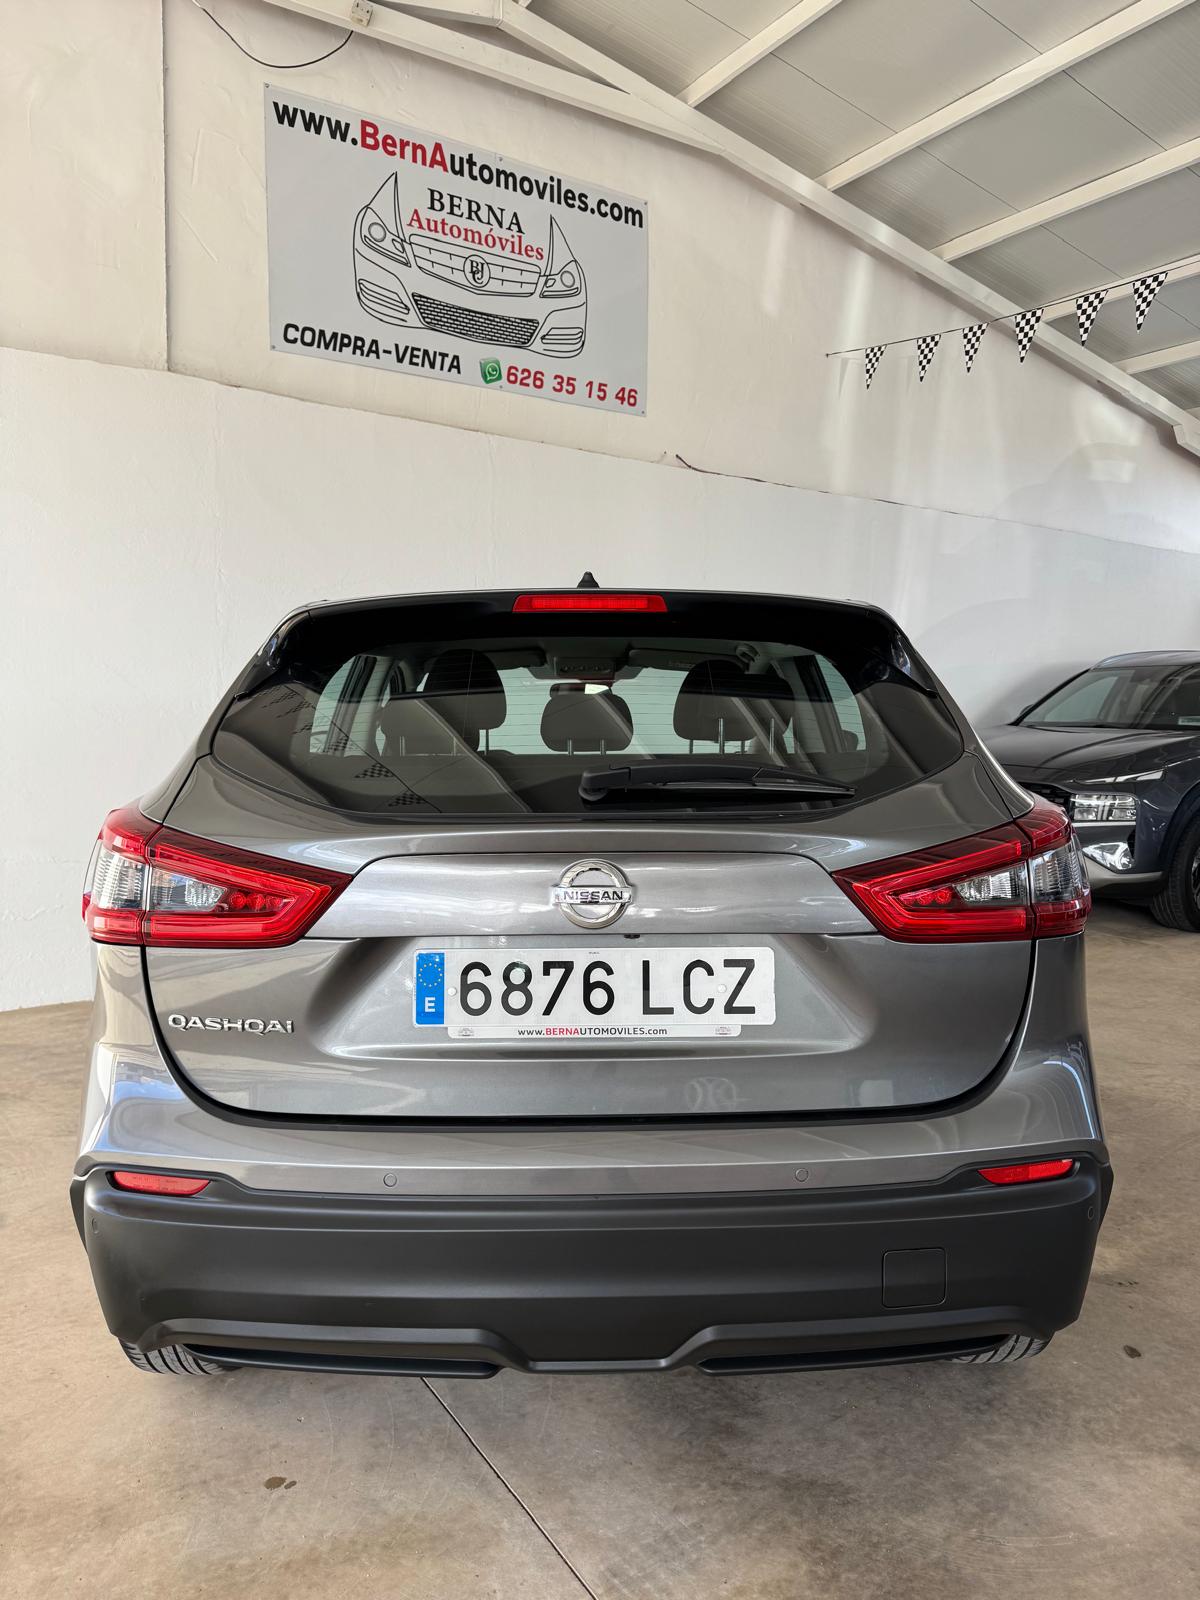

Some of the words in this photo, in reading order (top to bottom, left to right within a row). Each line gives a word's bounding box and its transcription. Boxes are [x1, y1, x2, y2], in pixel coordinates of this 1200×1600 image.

[272, 100, 645, 229] www.BernAutomoviles.com
[406, 207, 545, 261] Automóviles
[427, 187, 526, 235] BERNA
[282, 322, 463, 375] COMPRA-VENTA
[506, 365, 546, 390] 626
[552, 374, 577, 396] 35
[585, 380, 609, 402] 15
[614, 386, 639, 408] 46
[562, 889, 624, 901] NISSAN
[424, 996, 436, 1013] E
[459, 960, 616, 1017] 6876
[641, 958, 757, 1016] LCZ
[517, 1026, 669, 1037] www.BERNAUTOMOVILES.com
